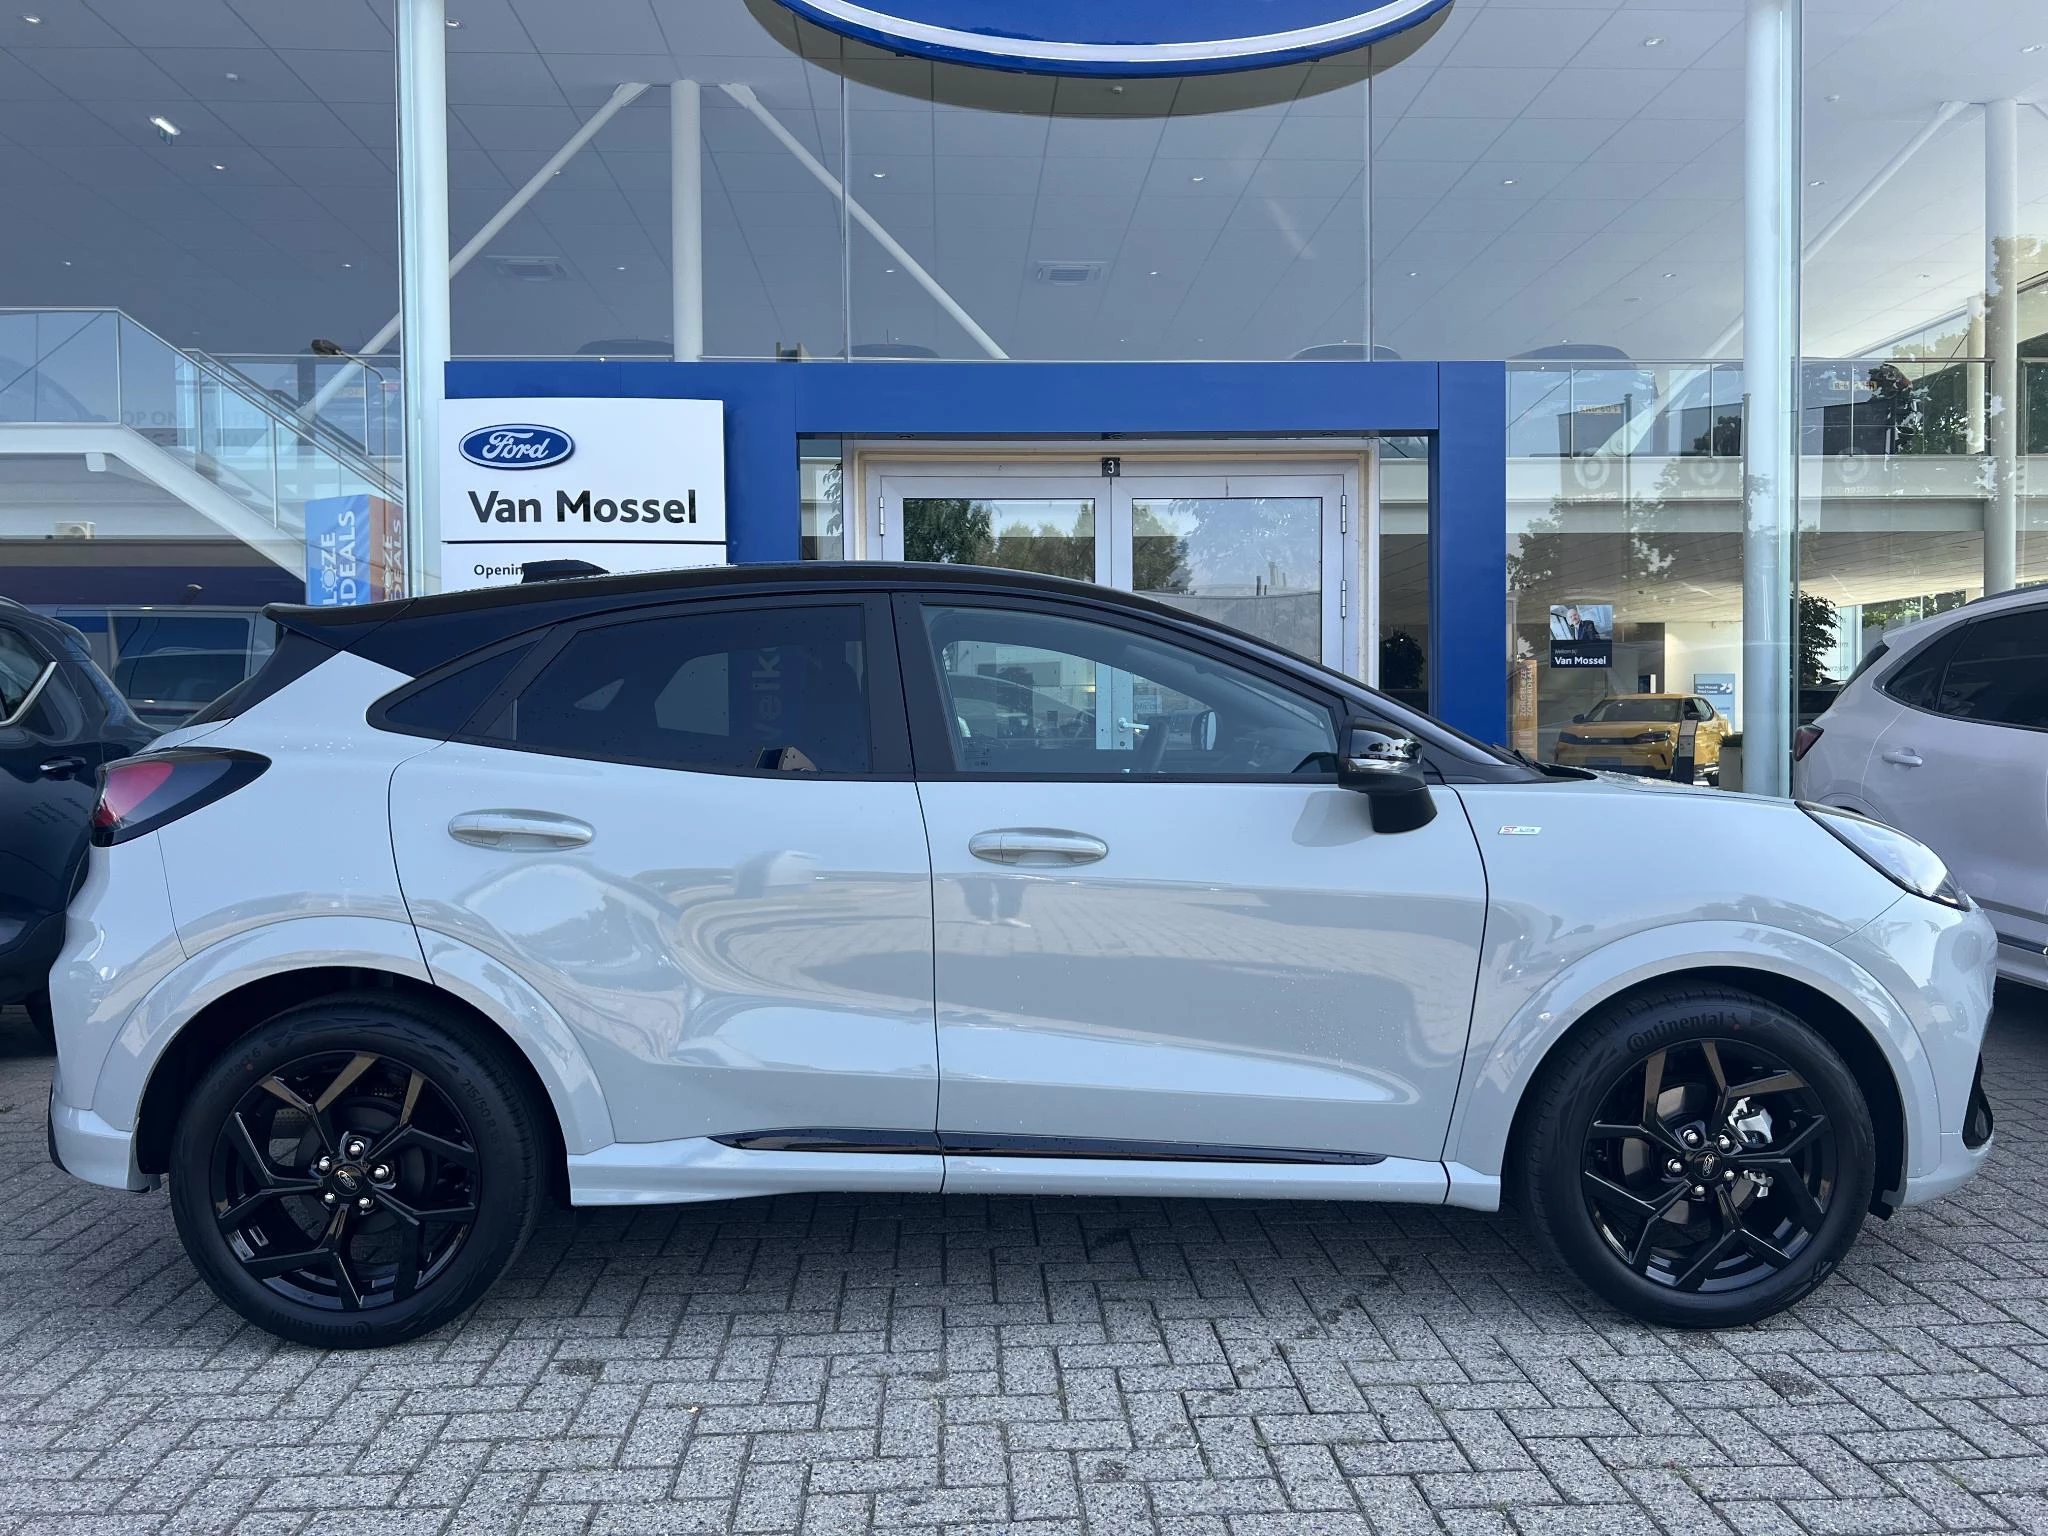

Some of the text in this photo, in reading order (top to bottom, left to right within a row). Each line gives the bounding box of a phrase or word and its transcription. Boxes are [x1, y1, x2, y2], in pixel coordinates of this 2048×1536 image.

[482, 430, 551, 460] Ford
[1107, 460, 1115, 474] 3
[468, 489, 697, 524] Van Mossel
[1554, 656, 1607, 665] Van Mossel
[1626, 1011, 1725, 1053] Continental
